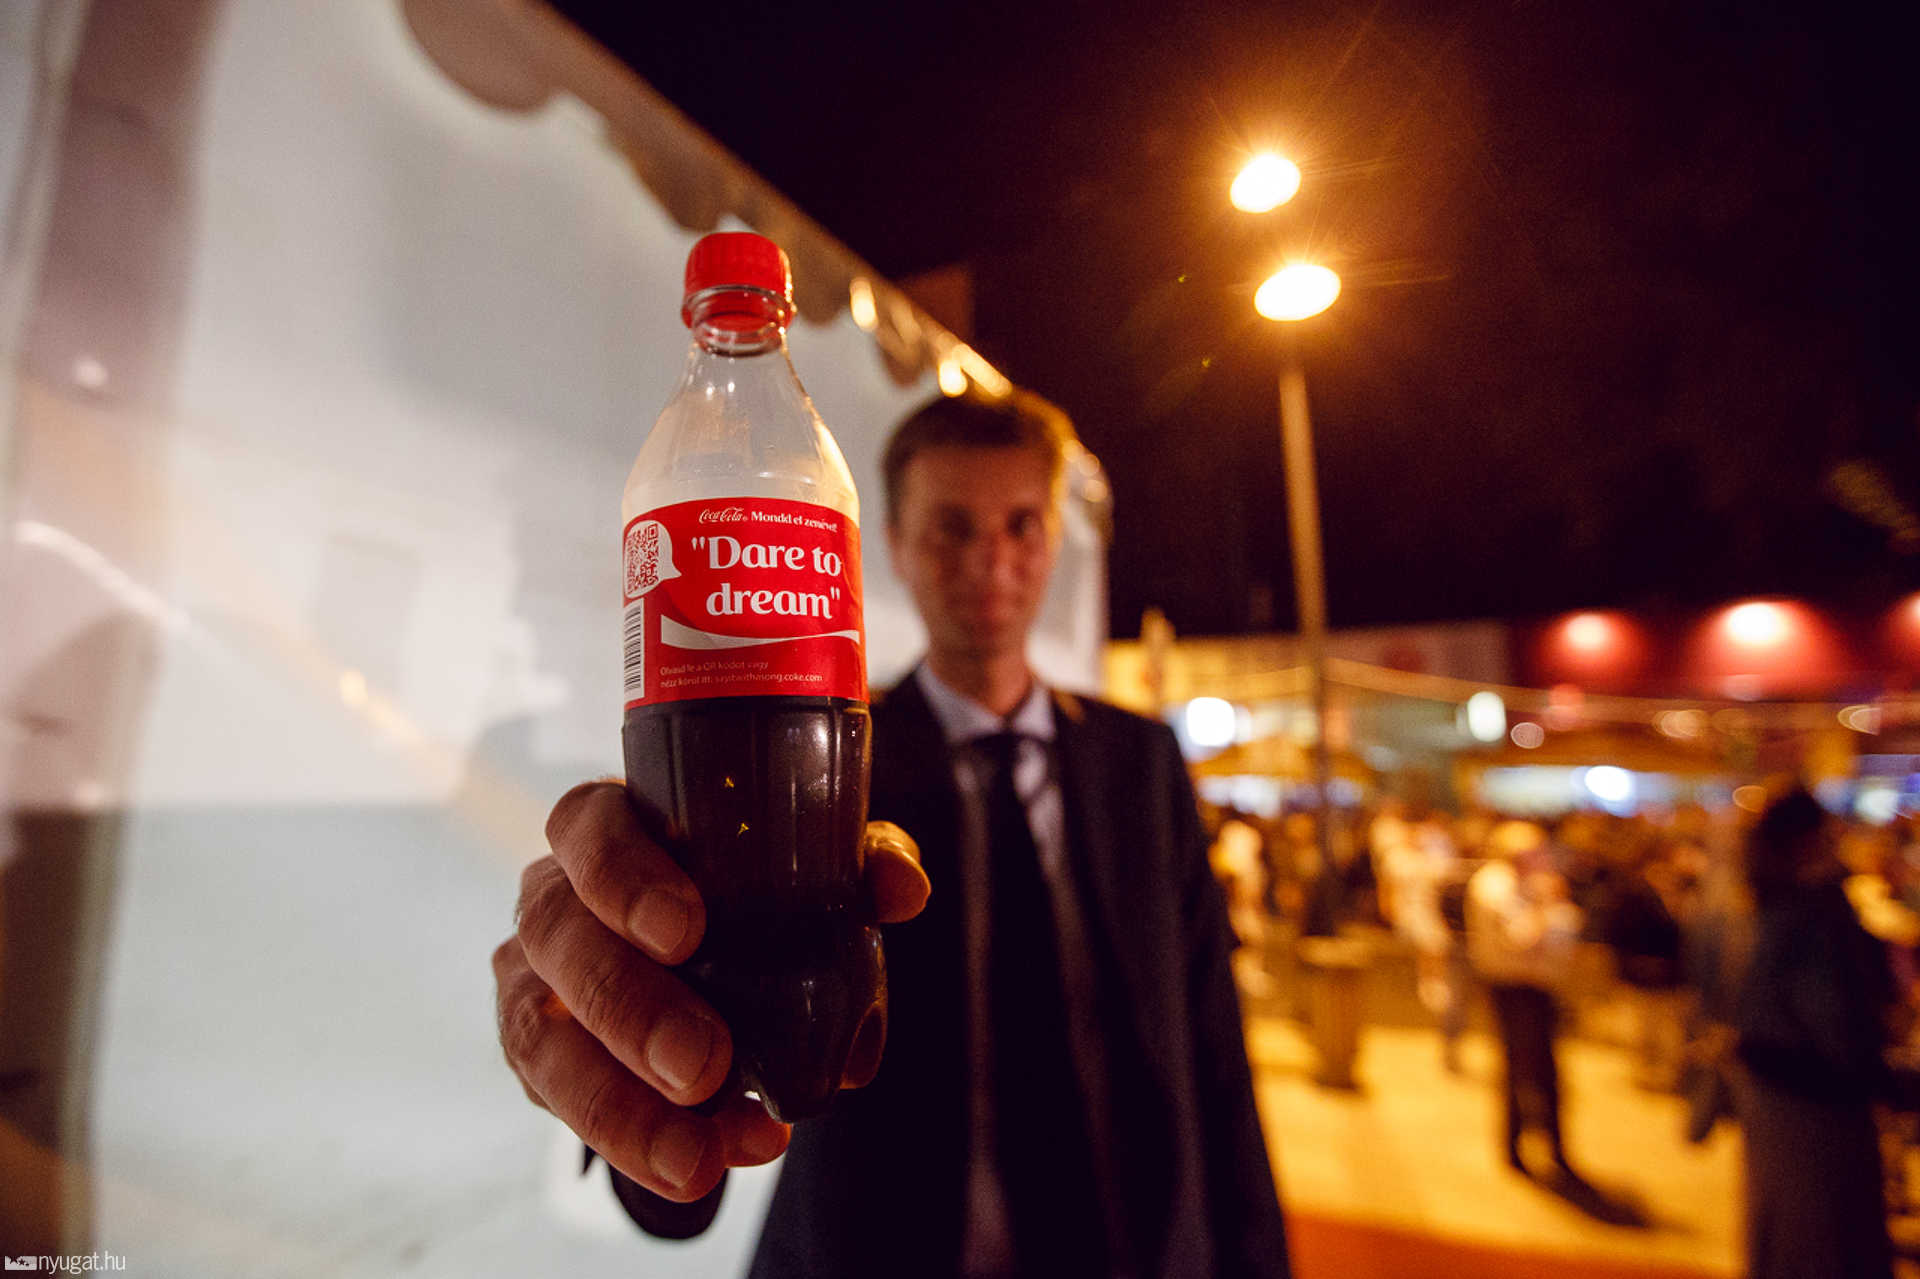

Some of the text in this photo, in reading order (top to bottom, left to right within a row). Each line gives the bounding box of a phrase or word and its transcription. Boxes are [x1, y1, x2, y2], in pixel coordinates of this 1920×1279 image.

[751, 511, 792, 524] Mondd
[691, 536, 842, 577] "Dare to
[706, 582, 840, 619] dream"
